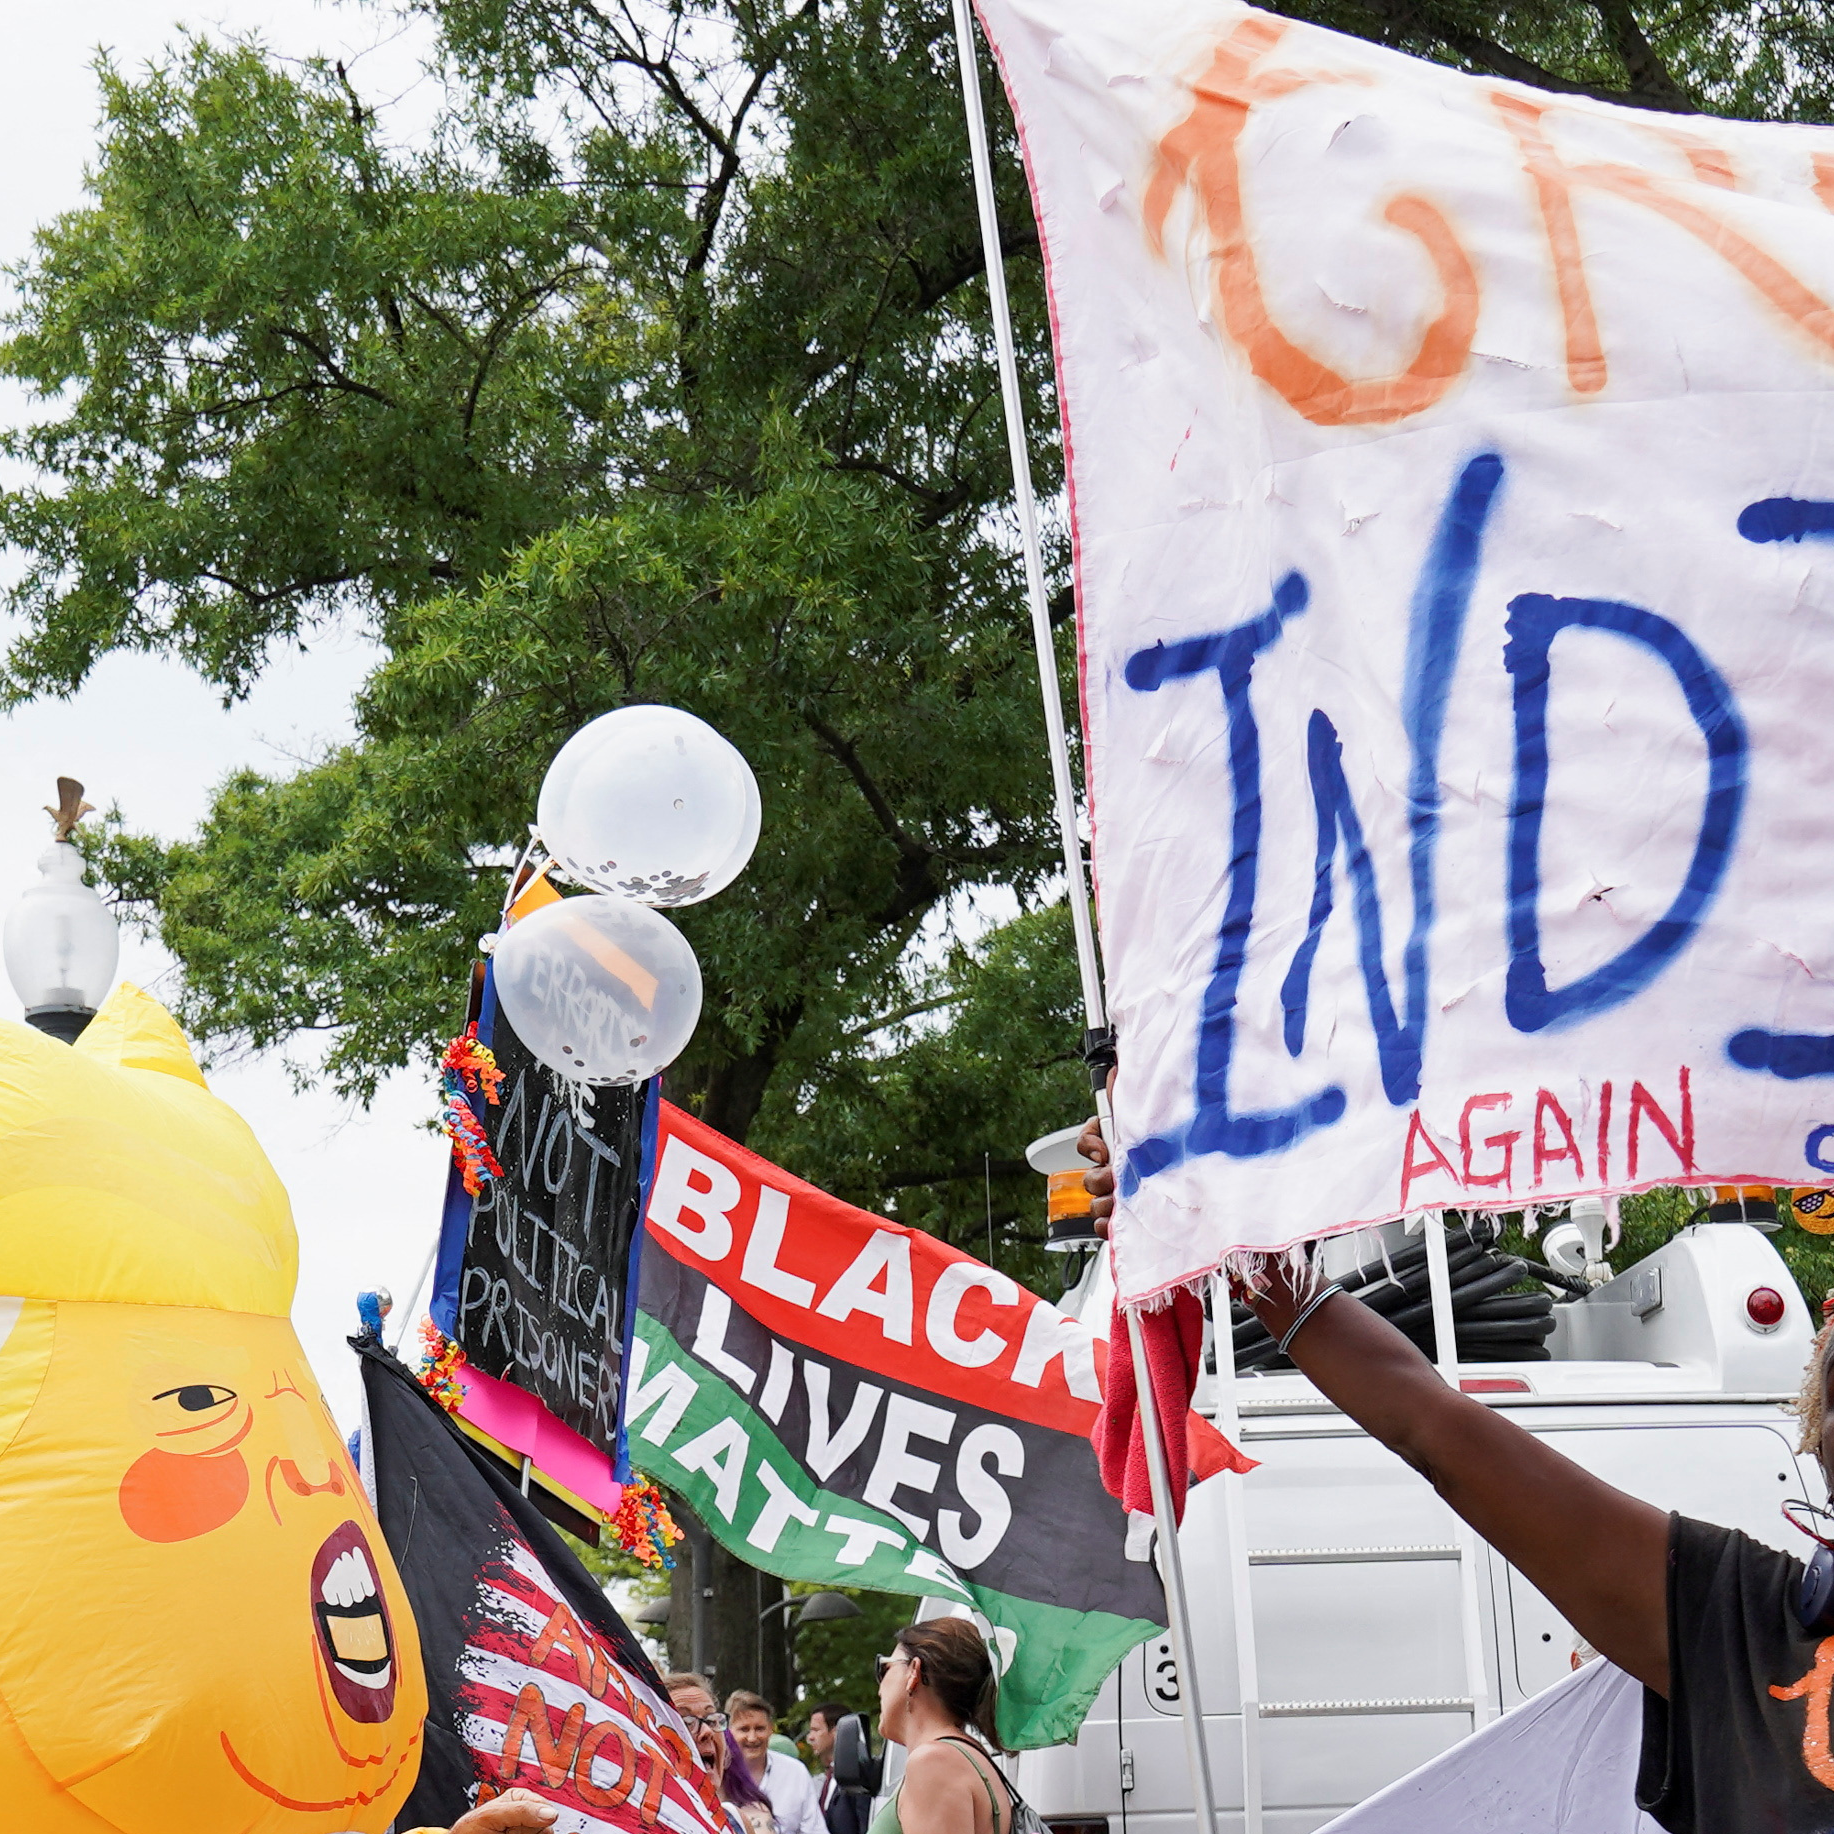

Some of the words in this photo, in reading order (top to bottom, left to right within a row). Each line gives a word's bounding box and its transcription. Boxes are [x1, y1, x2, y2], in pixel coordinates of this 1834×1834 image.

[495, 1068, 622, 1243] NOT
[1400, 1064, 1700, 1208] AGAIN
[467, 1178, 624, 1355] POLITICAL
[646, 1133, 1107, 1406] BLACK
[691, 1283, 1025, 1571] LIVES
[500, 1683, 680, 1827] NOT
